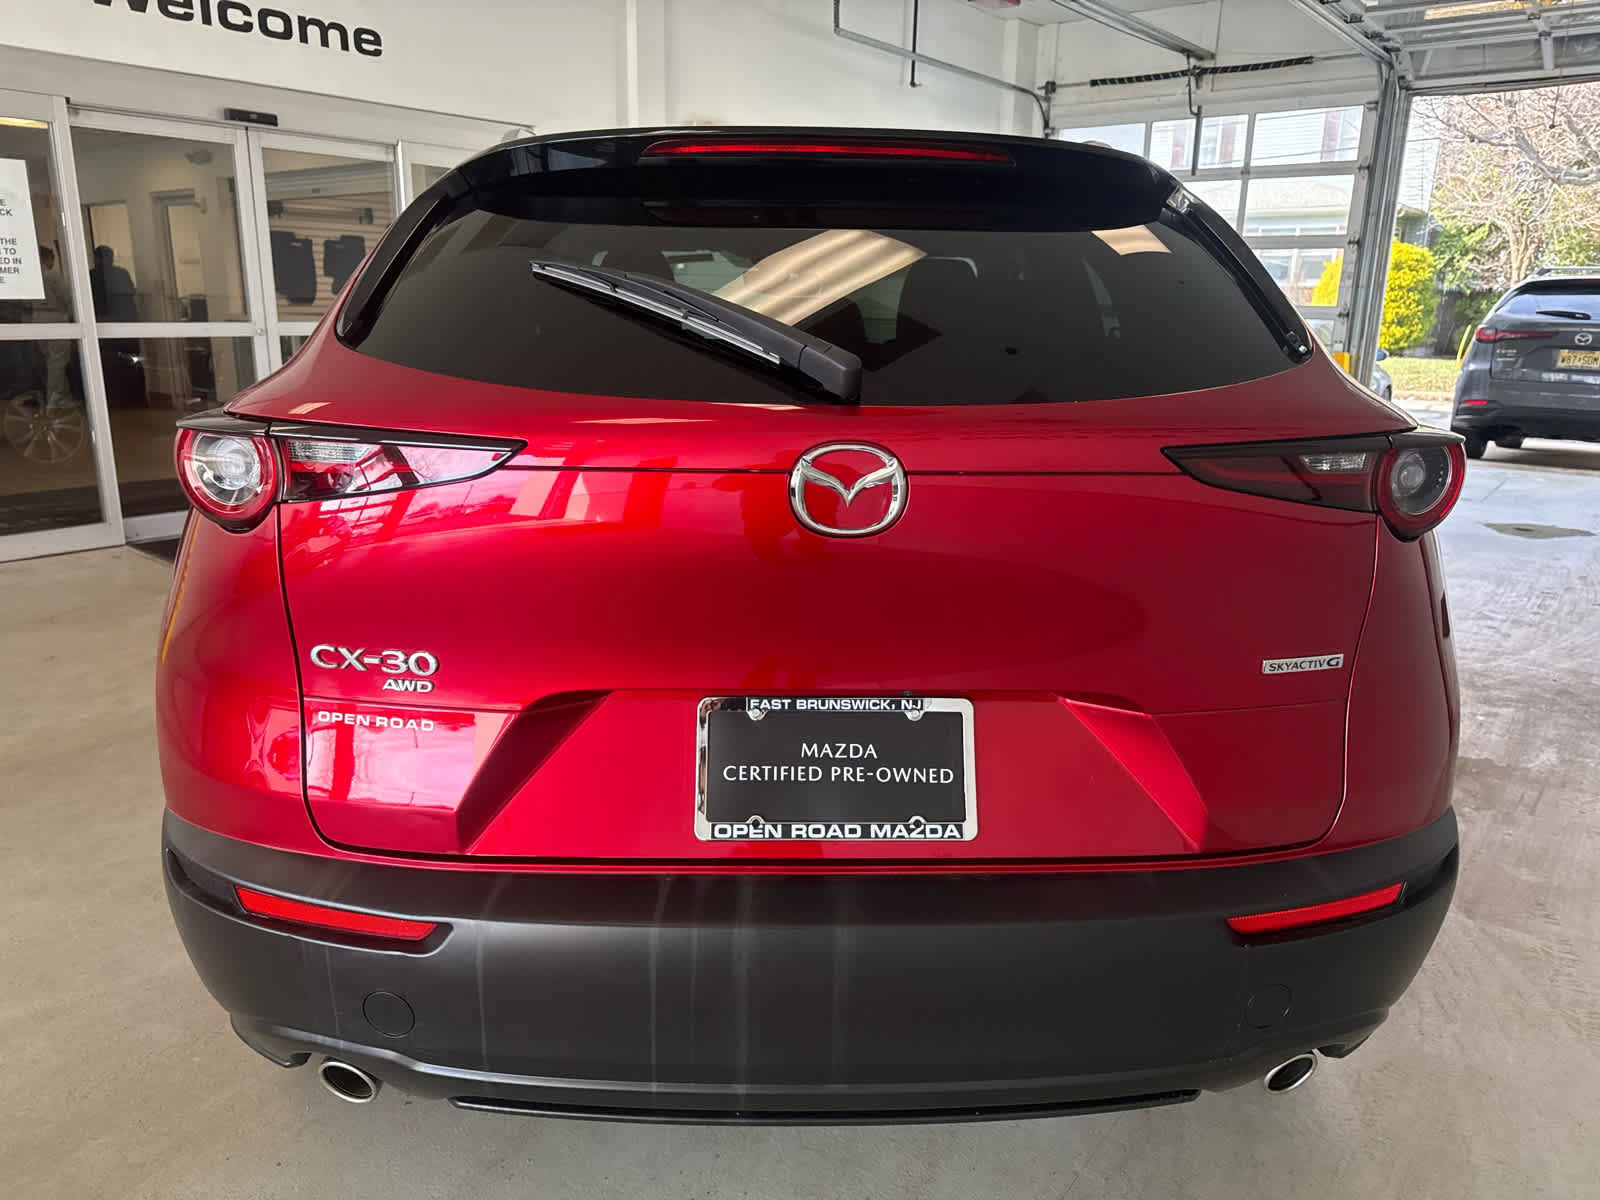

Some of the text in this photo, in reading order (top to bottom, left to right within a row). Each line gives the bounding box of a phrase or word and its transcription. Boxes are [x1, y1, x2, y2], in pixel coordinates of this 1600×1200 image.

[92, 0, 383, 57] elcome
[310, 644, 438, 677] CX-30
[382, 679, 434, 693] AWD
[901, 699, 921, 710] NJ
[318, 710, 434, 732] OPEN ROAD
[801, 743, 878, 759] MAZDA
[723, 765, 955, 784] CERTIFIED PRE-OWNED
[713, 823, 961, 839] OPEN ROAD MAZDA
